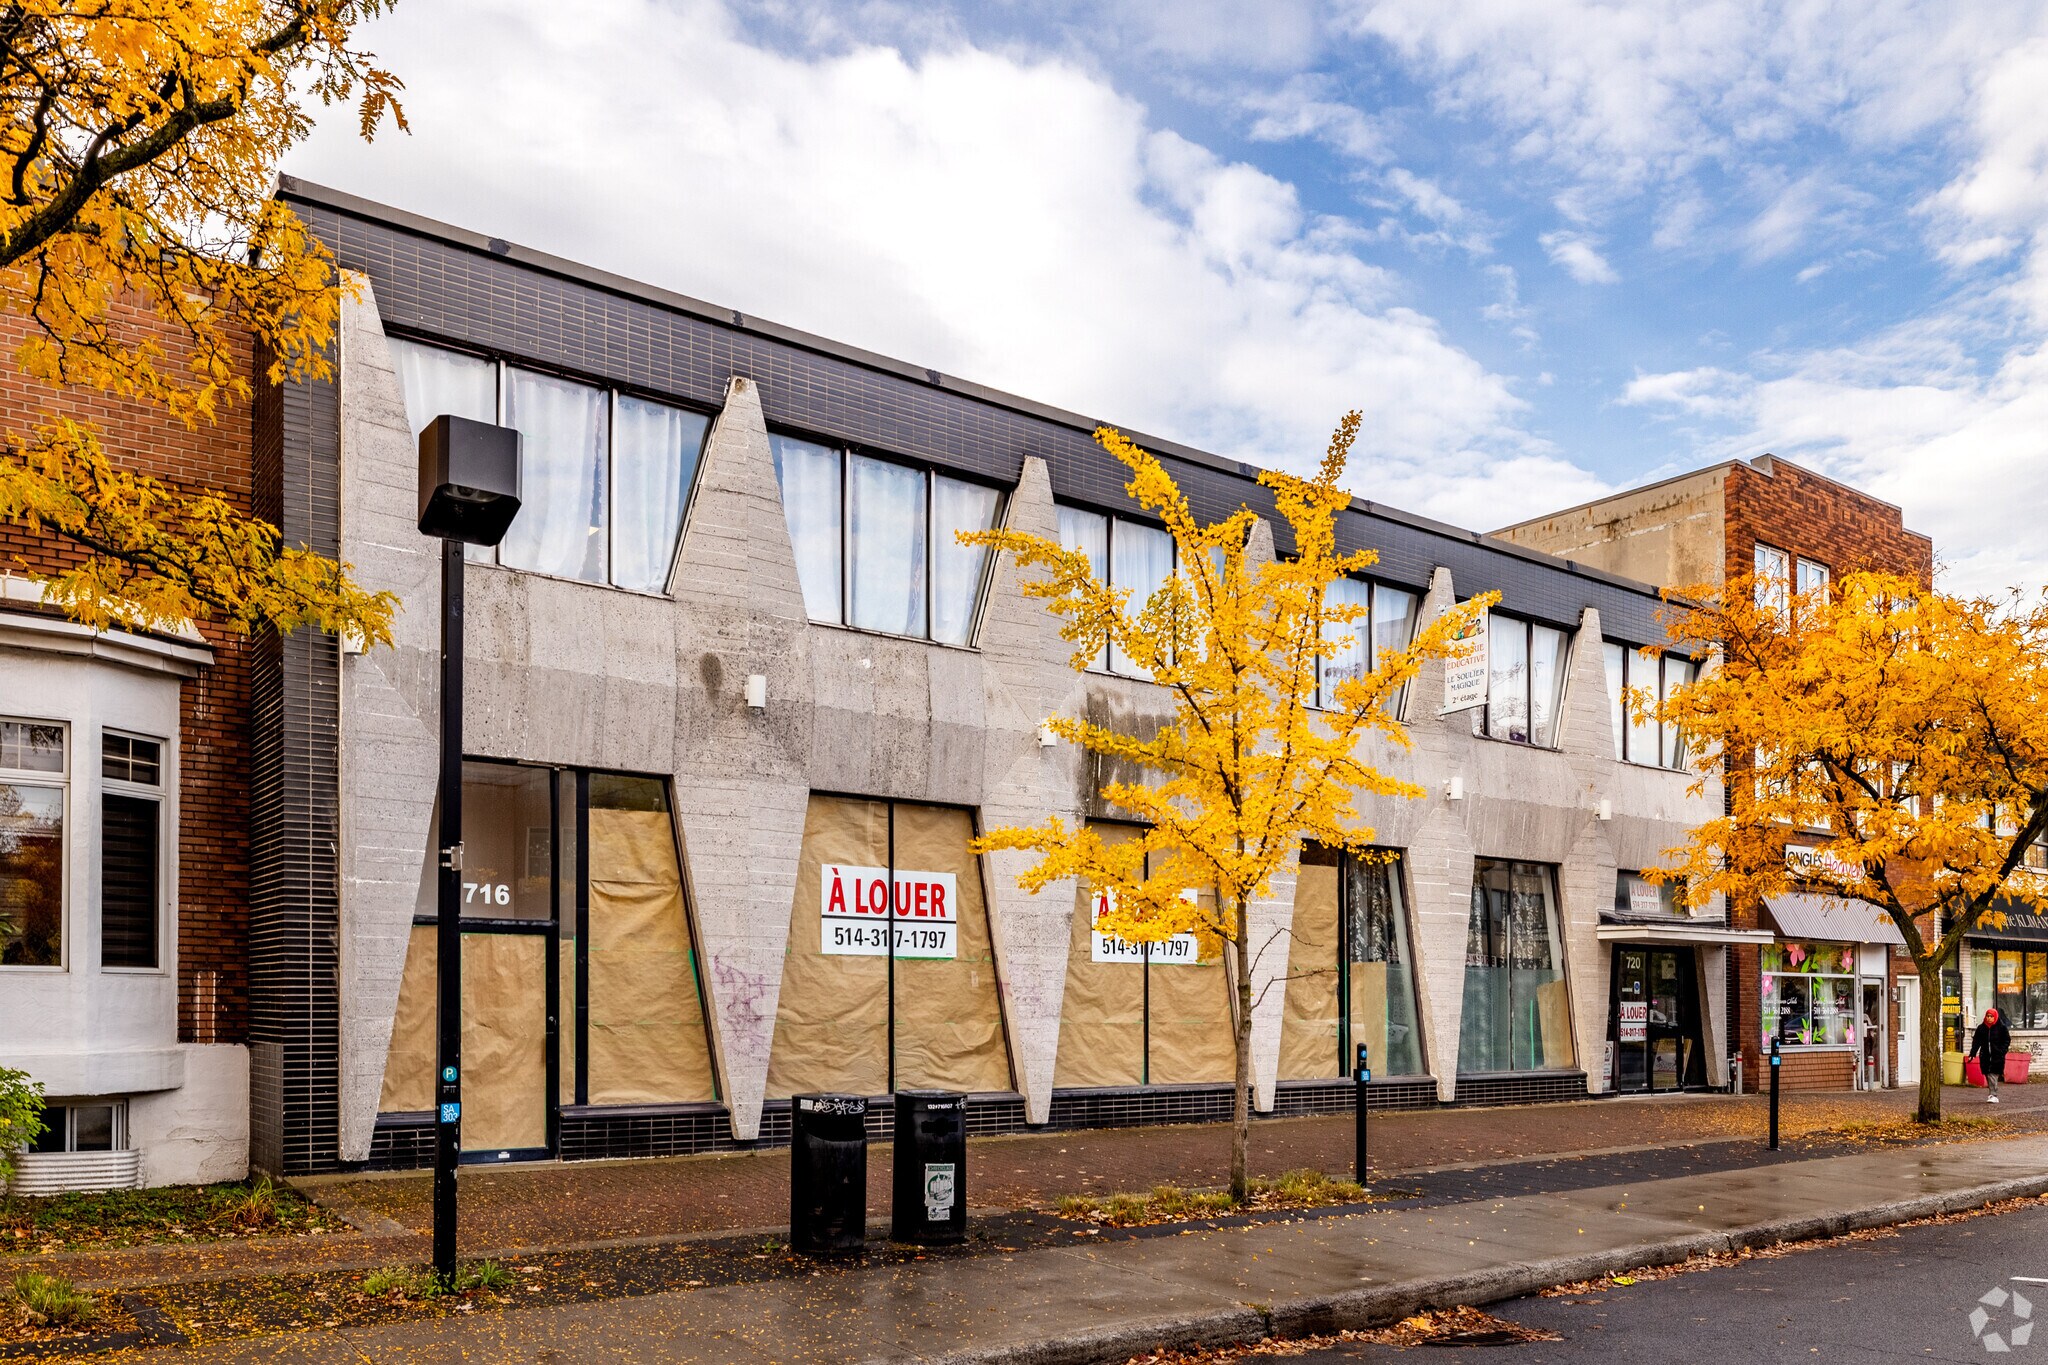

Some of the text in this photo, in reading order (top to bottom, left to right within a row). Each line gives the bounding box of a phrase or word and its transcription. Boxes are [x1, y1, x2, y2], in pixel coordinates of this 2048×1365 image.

[1446, 654, 1486, 671] ÉDUCATIVE
[1447, 668, 1485, 684] LE SOULIER
[1450, 679, 1480, 691] MAGIQUE
[1460, 692, 1478, 702] étage
[463, 882, 510, 906] 716
[828, 867, 947, 918] À LOUER
[834, 927, 947, 949] 514-317-1797
[1102, 938, 1189, 957] 514-317-1797
[1626, 956, 1641, 969] 720
[1626, 1006, 1647, 1020] LOUER
[443, 1104, 454, 1113] SA
